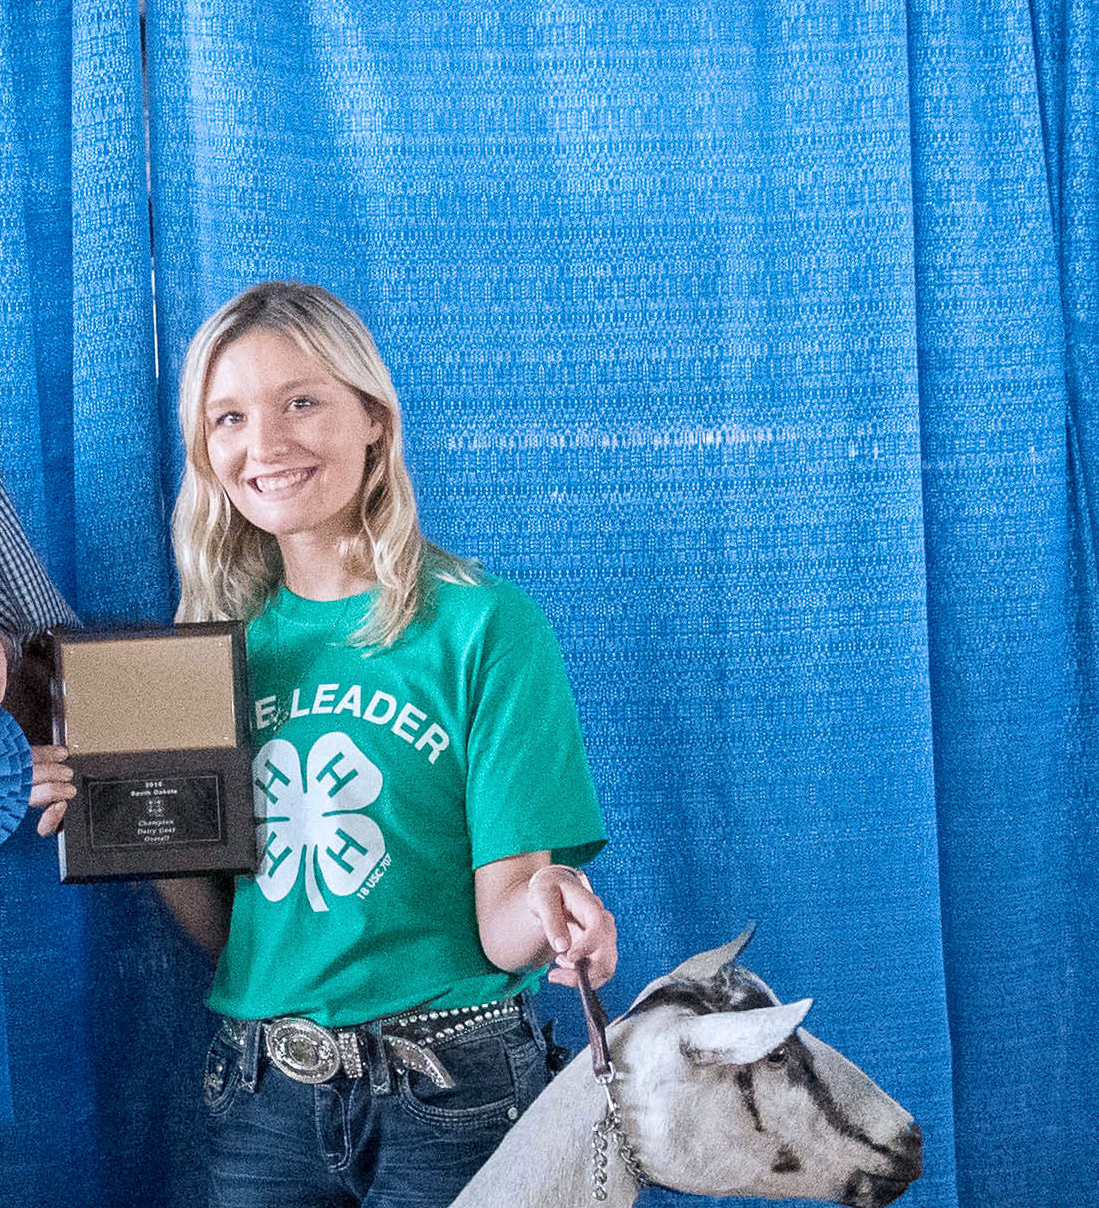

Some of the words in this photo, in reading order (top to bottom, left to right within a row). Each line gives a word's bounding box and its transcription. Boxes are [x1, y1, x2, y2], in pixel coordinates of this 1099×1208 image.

[290, 683, 450, 765] LEADER
[356, 887, 370, 900] 18
[365, 868, 385, 888] USC
